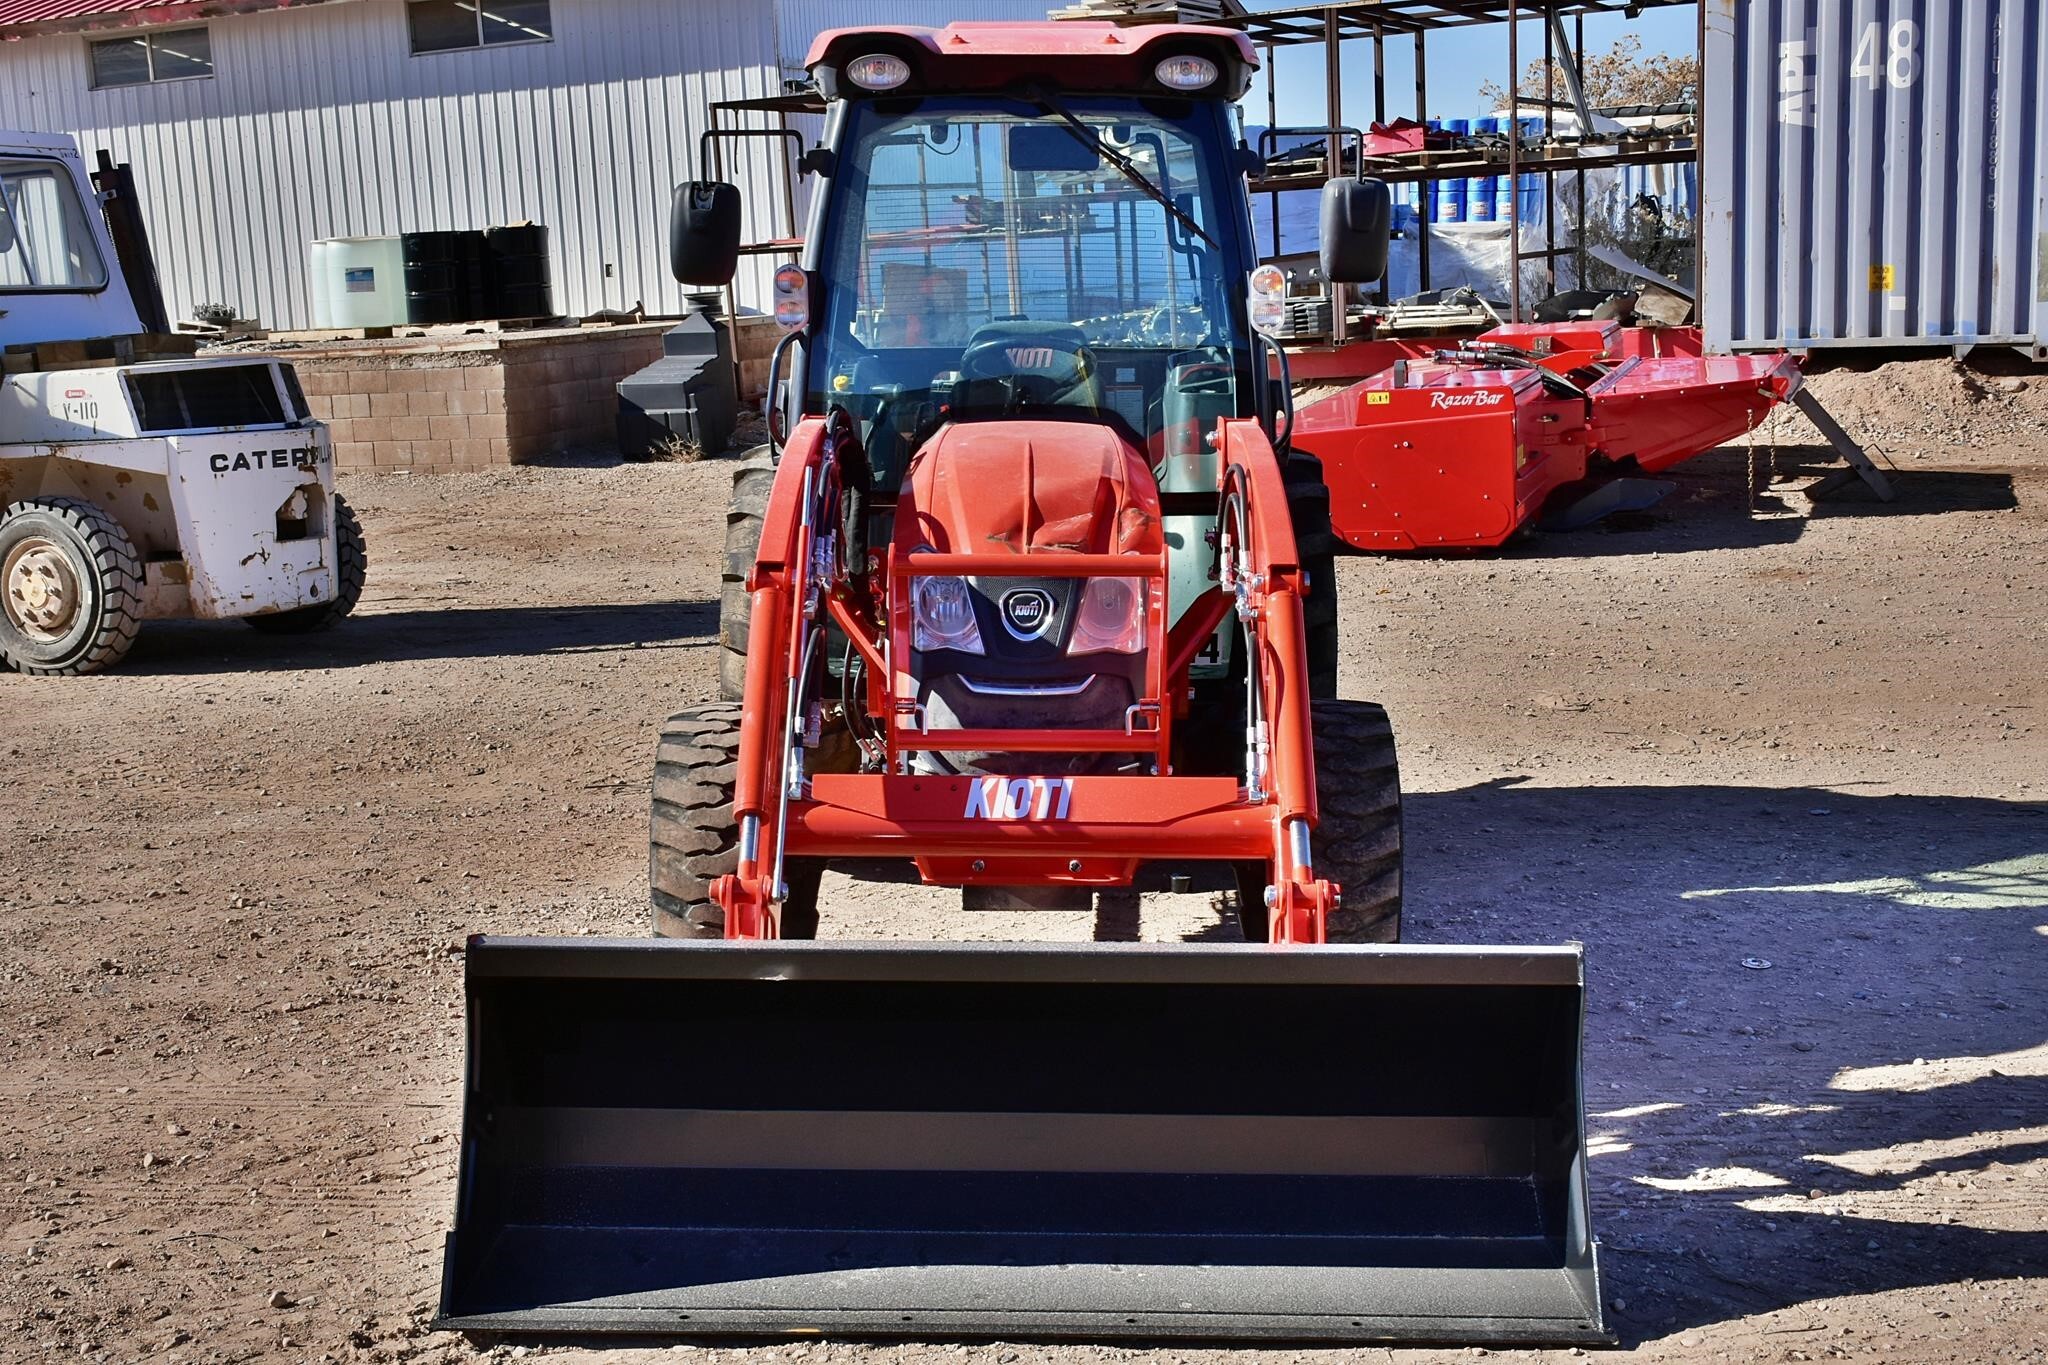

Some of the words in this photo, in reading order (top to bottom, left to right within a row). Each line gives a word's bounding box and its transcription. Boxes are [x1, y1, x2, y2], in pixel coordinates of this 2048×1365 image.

[1850, 19, 1921, 90] 48
[1430, 390, 1504, 410] RazorBar
[1014, 600, 1040, 616] KIOTI
[964, 777, 1075, 820] KIOTI
